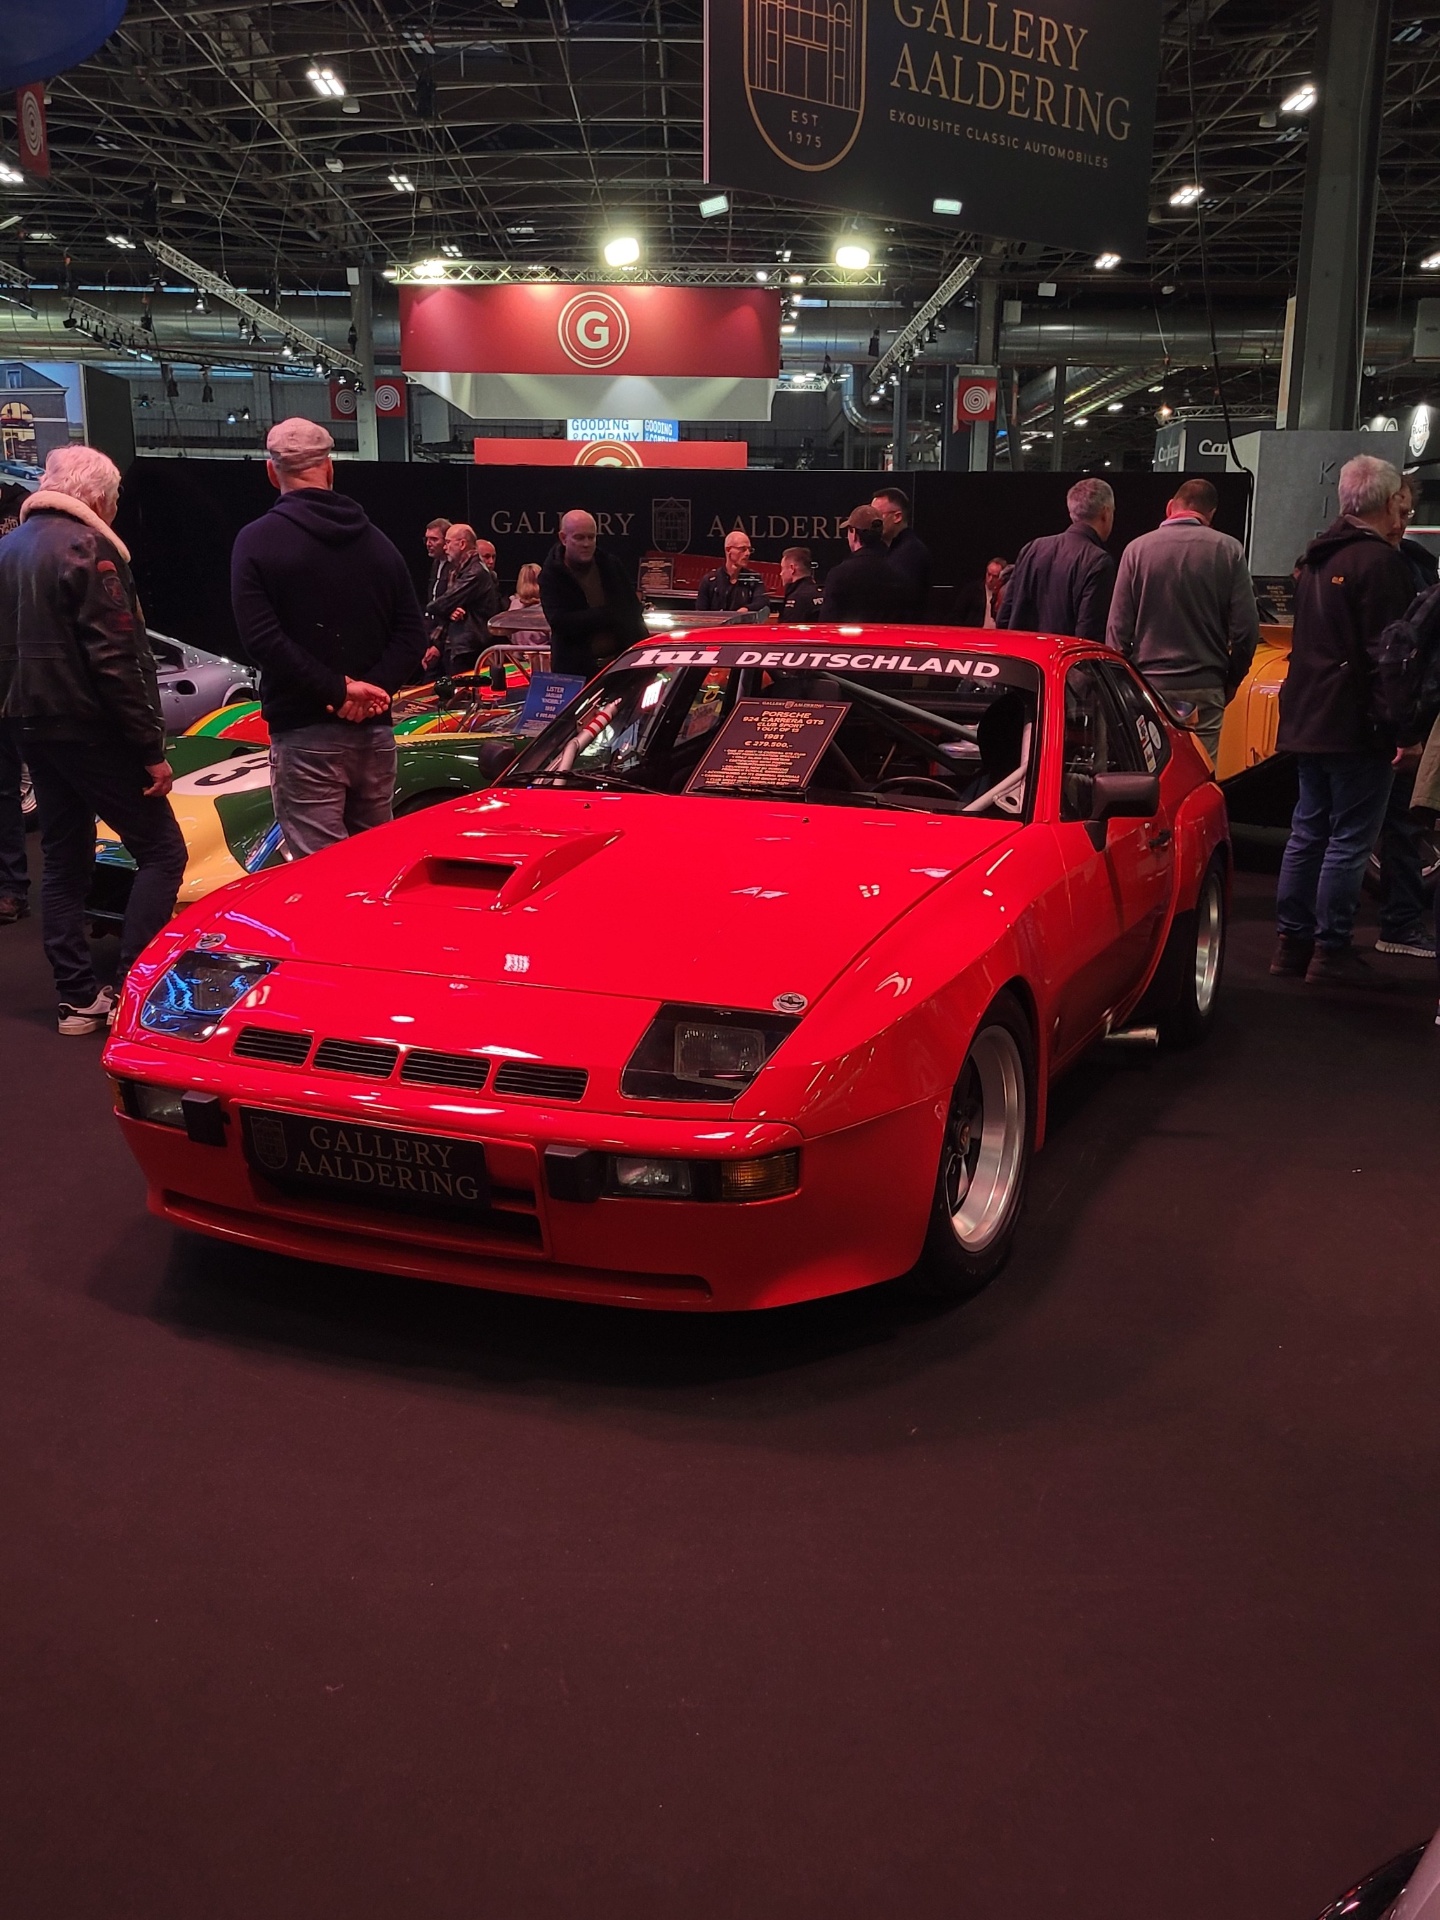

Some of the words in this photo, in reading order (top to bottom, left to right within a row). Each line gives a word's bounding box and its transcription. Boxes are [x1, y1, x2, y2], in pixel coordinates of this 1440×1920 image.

[893, 0, 1088, 71] GALLERY
[890, 43, 1131, 140] AALDERING
[788, 131, 822, 148] 1975
[889, 109, 961, 136] EXQUISITE
[967, 127, 1020, 149] CLASSIC
[1024, 141, 1109, 168] AUTOMOBILES
[577, 311, 609, 349] G
[571, 420, 629, 431] GOODING
[645, 420, 673, 436] GOODING
[735, 651, 1000, 678] DEUTSCHLAND
[309, 1126, 453, 1168] GALLERY
[296, 1151, 479, 1200] AALDERING
